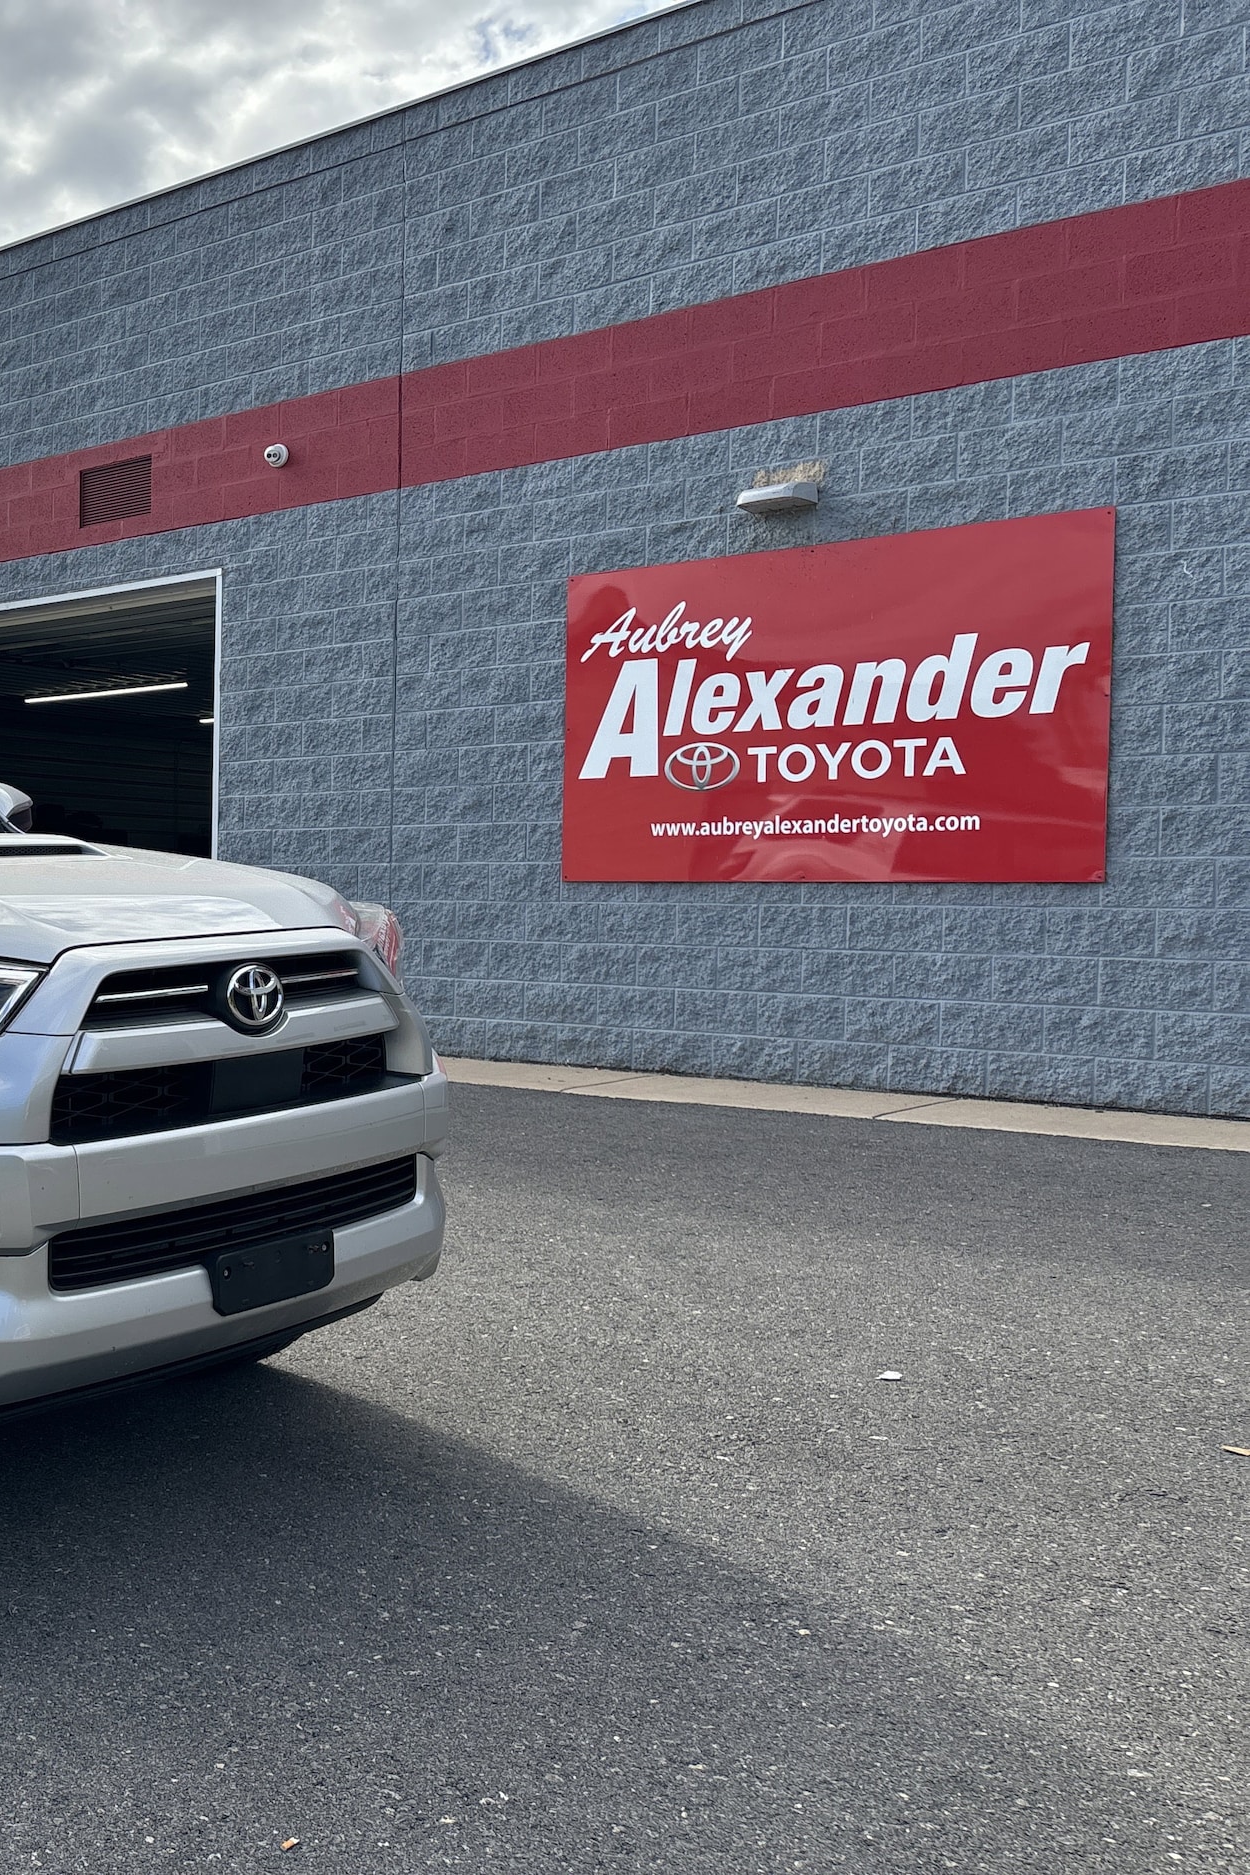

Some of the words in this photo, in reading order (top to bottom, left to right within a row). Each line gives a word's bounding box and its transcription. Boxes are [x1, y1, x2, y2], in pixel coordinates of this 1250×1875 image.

[580, 600, 753, 663] Aubrey
[578, 632, 1091, 780] Alexander
[747, 736, 967, 783] TOYOTA
[650, 812, 981, 840] www.aubreyalexandertoyota.com
